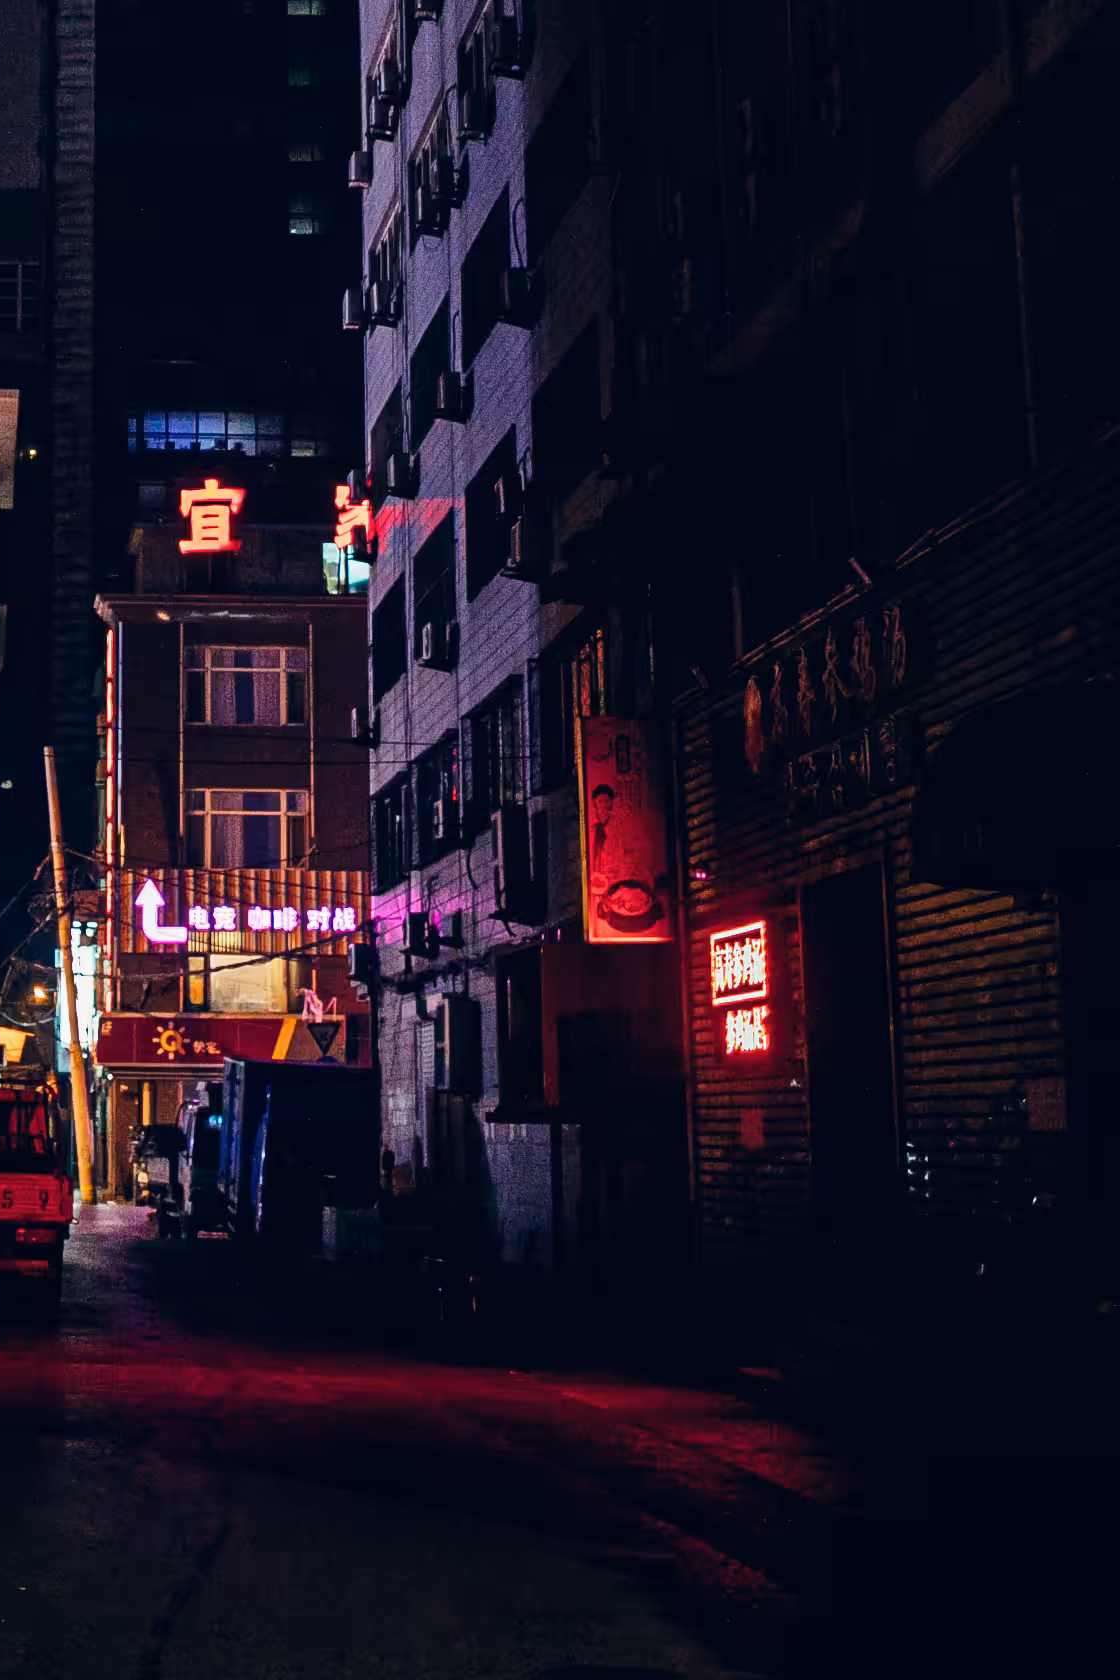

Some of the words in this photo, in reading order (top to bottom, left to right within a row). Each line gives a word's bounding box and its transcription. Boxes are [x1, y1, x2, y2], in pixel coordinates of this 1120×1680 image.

[178, 478, 246, 555] 宜
[188, 905, 236, 931] 电竞
[247, 905, 298, 931] 咖啡
[306, 905, 357, 931] 对战
